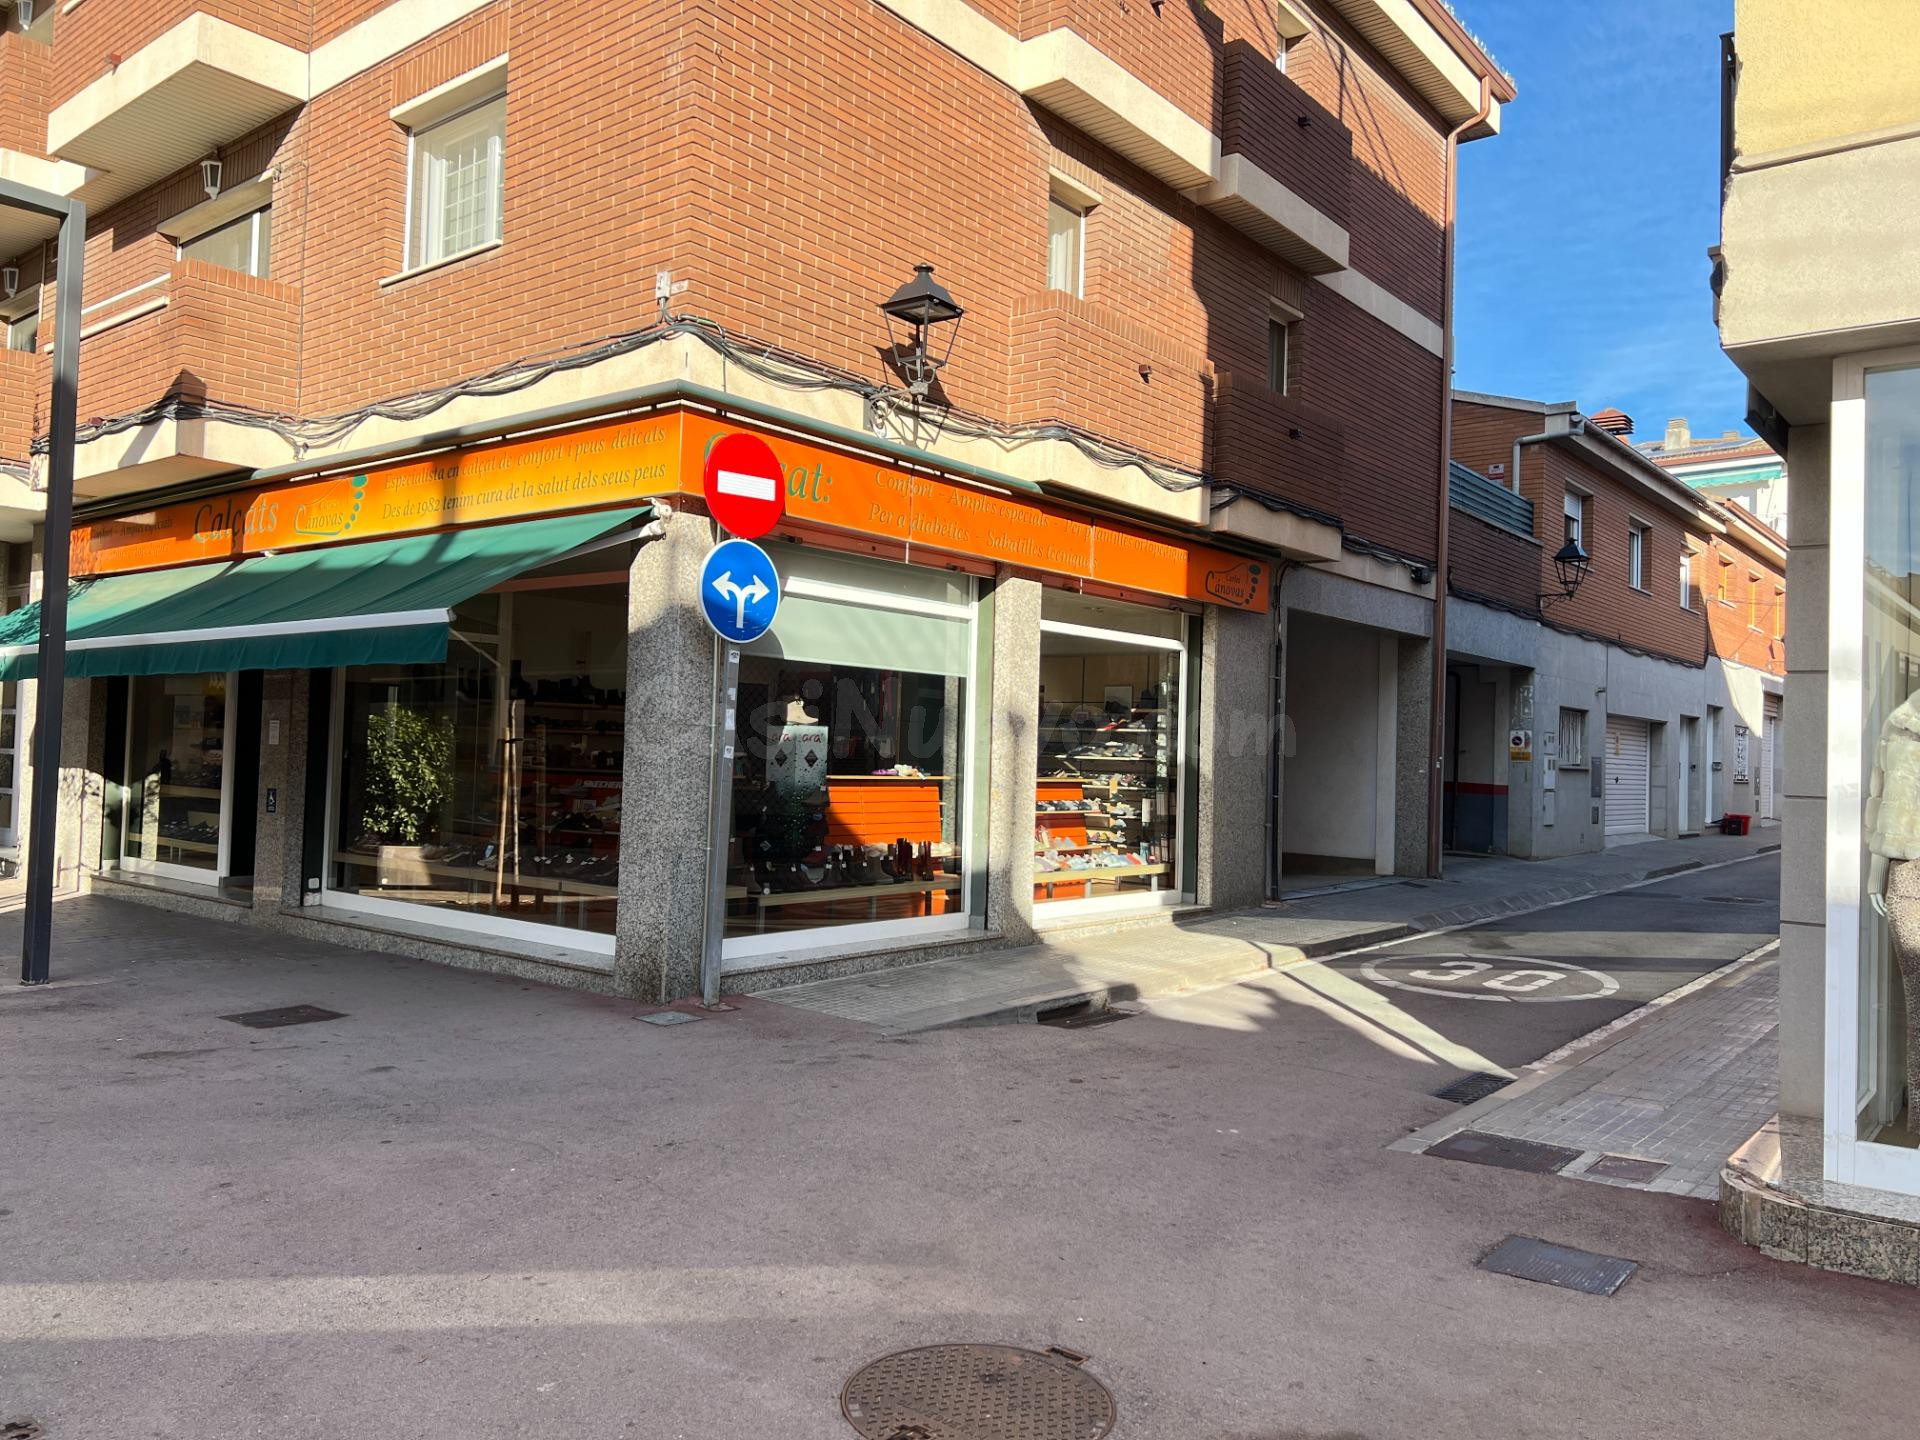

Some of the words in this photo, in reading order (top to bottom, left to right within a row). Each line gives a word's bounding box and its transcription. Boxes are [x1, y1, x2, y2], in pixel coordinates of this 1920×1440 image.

[383, 463, 444, 493] Especialista
[447, 464, 459, 478] en
[462, 457, 496, 479] calçat
[499, 452, 511, 469] de
[517, 445, 563, 469] confort
[567, 439, 573, 457] i
[575, 440, 605, 462] peus
[611, 425, 665, 449] delicats
[382, 503, 401, 519] Des
[402, 500, 414, 517] de
[417, 497, 440, 515] 1982
[443, 492, 474, 512] tenim
[477, 489, 503, 505] cura
[505, 483, 520, 501] de
[522, 480, 534, 498] la
[537, 473, 570, 496] salut
[572, 470, 597, 490] dels
[601, 469, 630, 486] seus
[633, 463, 666, 484] peus
[868, 503, 894, 524] Per
[896, 515, 906, 529] a
[875, 469, 934, 498] Confort
[949, 489, 997, 515] Amples
[999, 504, 1048, 527] especials
[194, 495, 279, 549] Calçats
[802, 733, 822, 743] ara
[1408, 961, 1568, 992] 30
